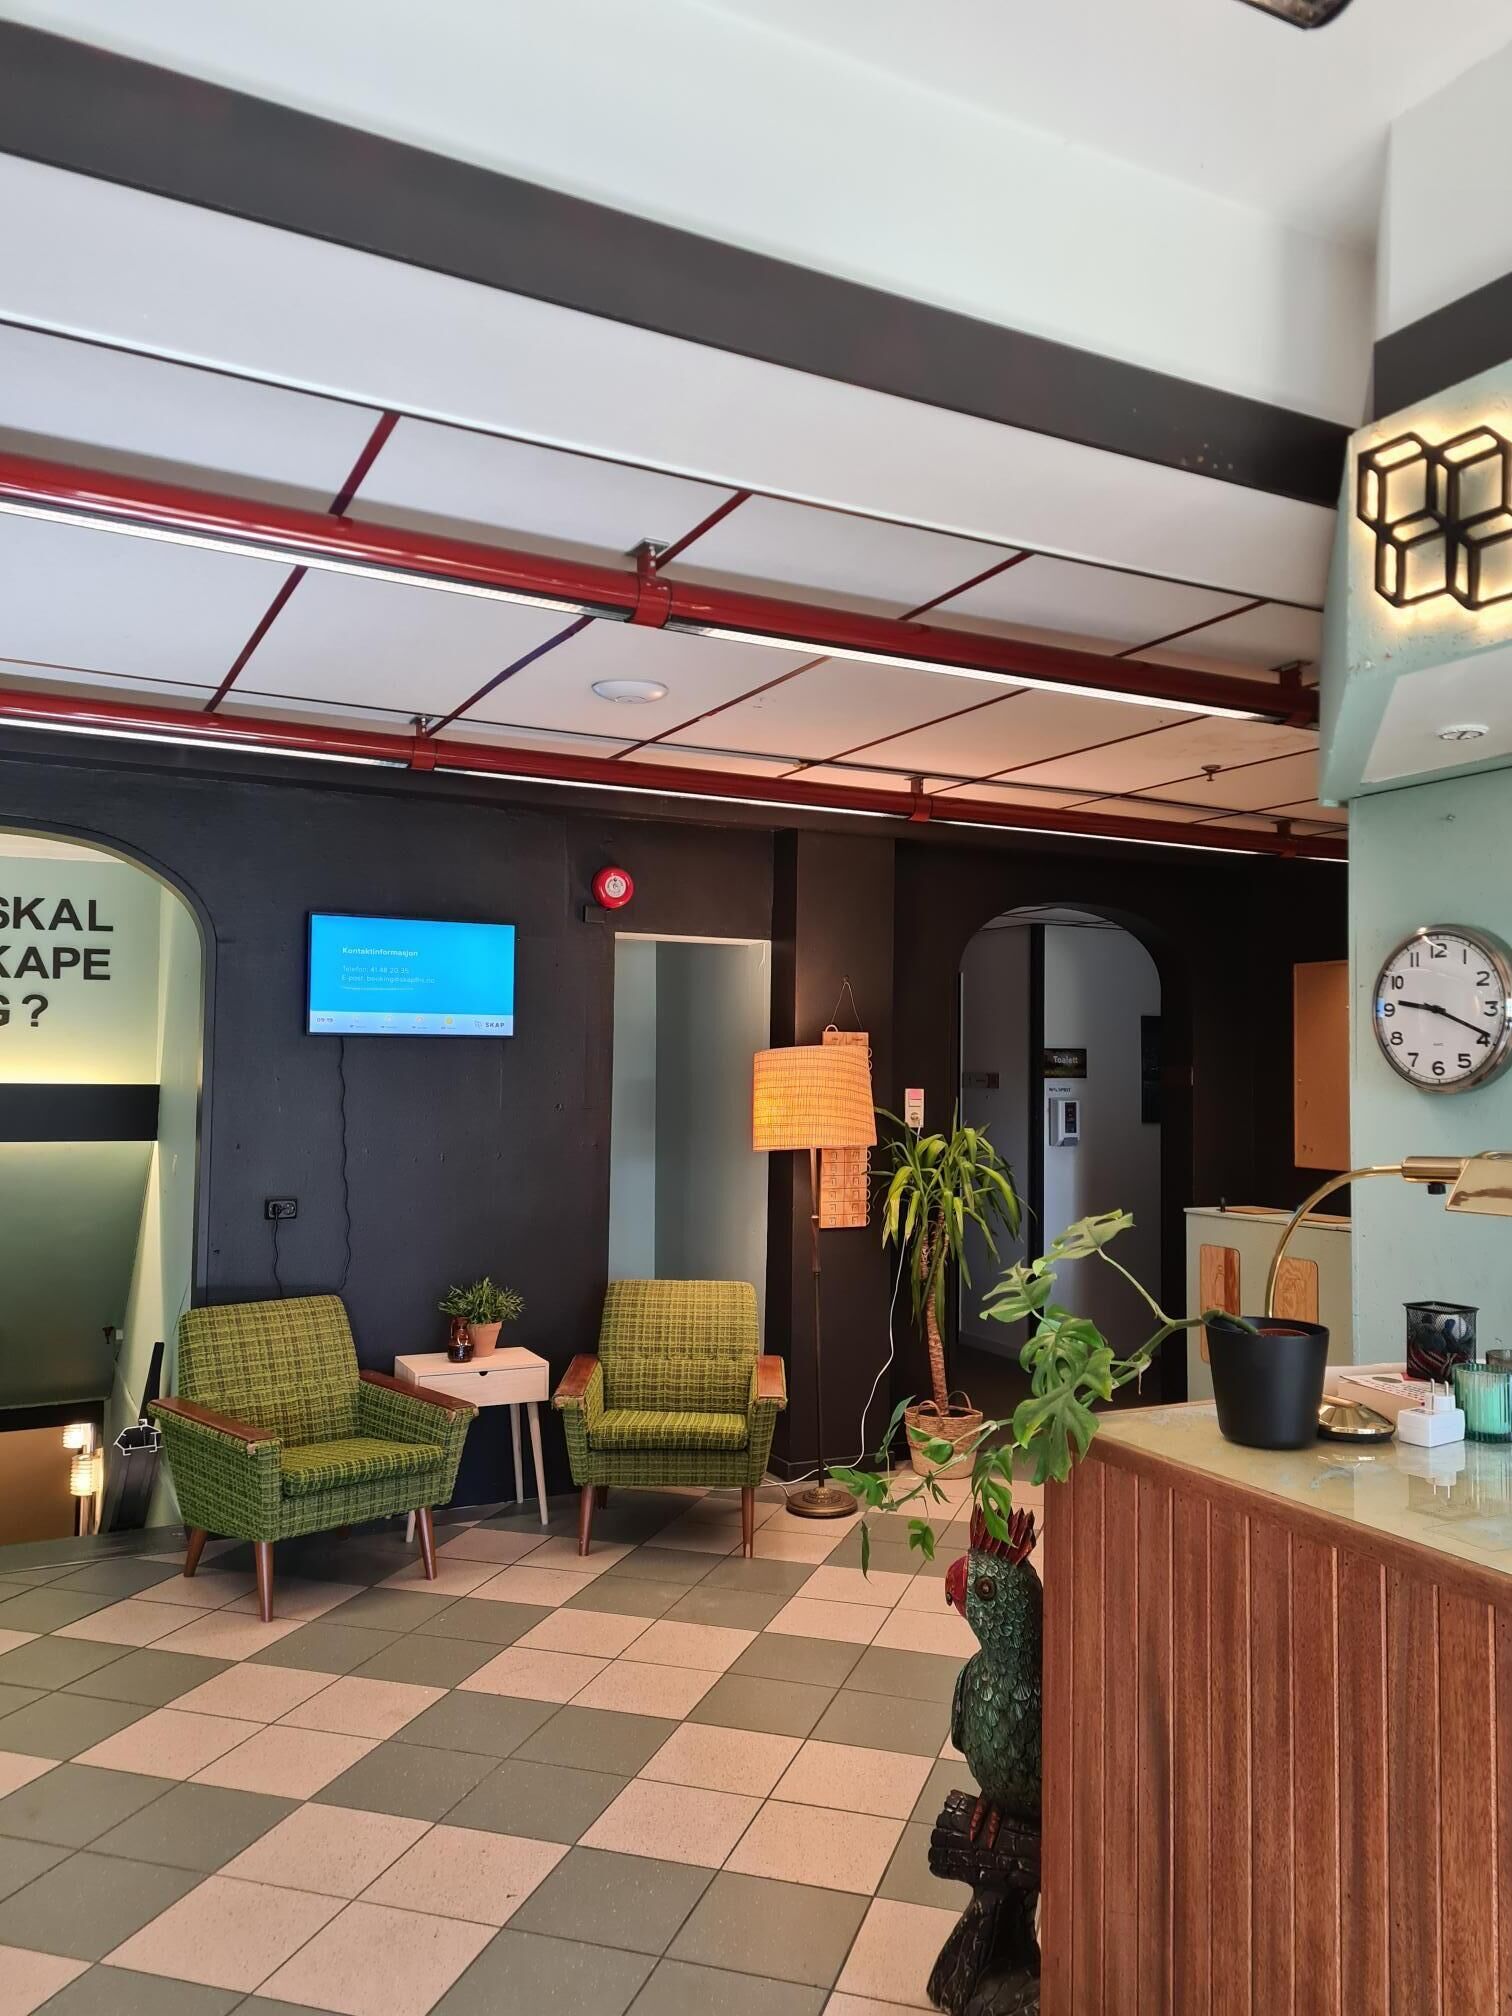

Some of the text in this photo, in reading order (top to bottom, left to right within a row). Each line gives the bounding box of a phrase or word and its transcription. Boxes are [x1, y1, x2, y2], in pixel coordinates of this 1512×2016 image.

[342, 946, 419, 958] Kontaktinformasjon
[1431, 943, 1448, 959] 12
[1463, 949, 1467, 965] 1
[1410, 951, 1420, 968] 11
[1391, 975, 1405, 990] 10
[1476, 971, 1490, 987] 2
[1384, 1003, 1396, 1017] 9
[1483, 1001, 1499, 1017] 3
[1390, 1031, 1404, 1046] 8
[1476, 1032, 1491, 1047] 4
[1053, 1055, 1079, 1064] Toalett
[1408, 1052, 1420, 1067] 7
[1457, 1053, 1472, 1069] 5
[1432, 1061, 1446, 1076] 6
